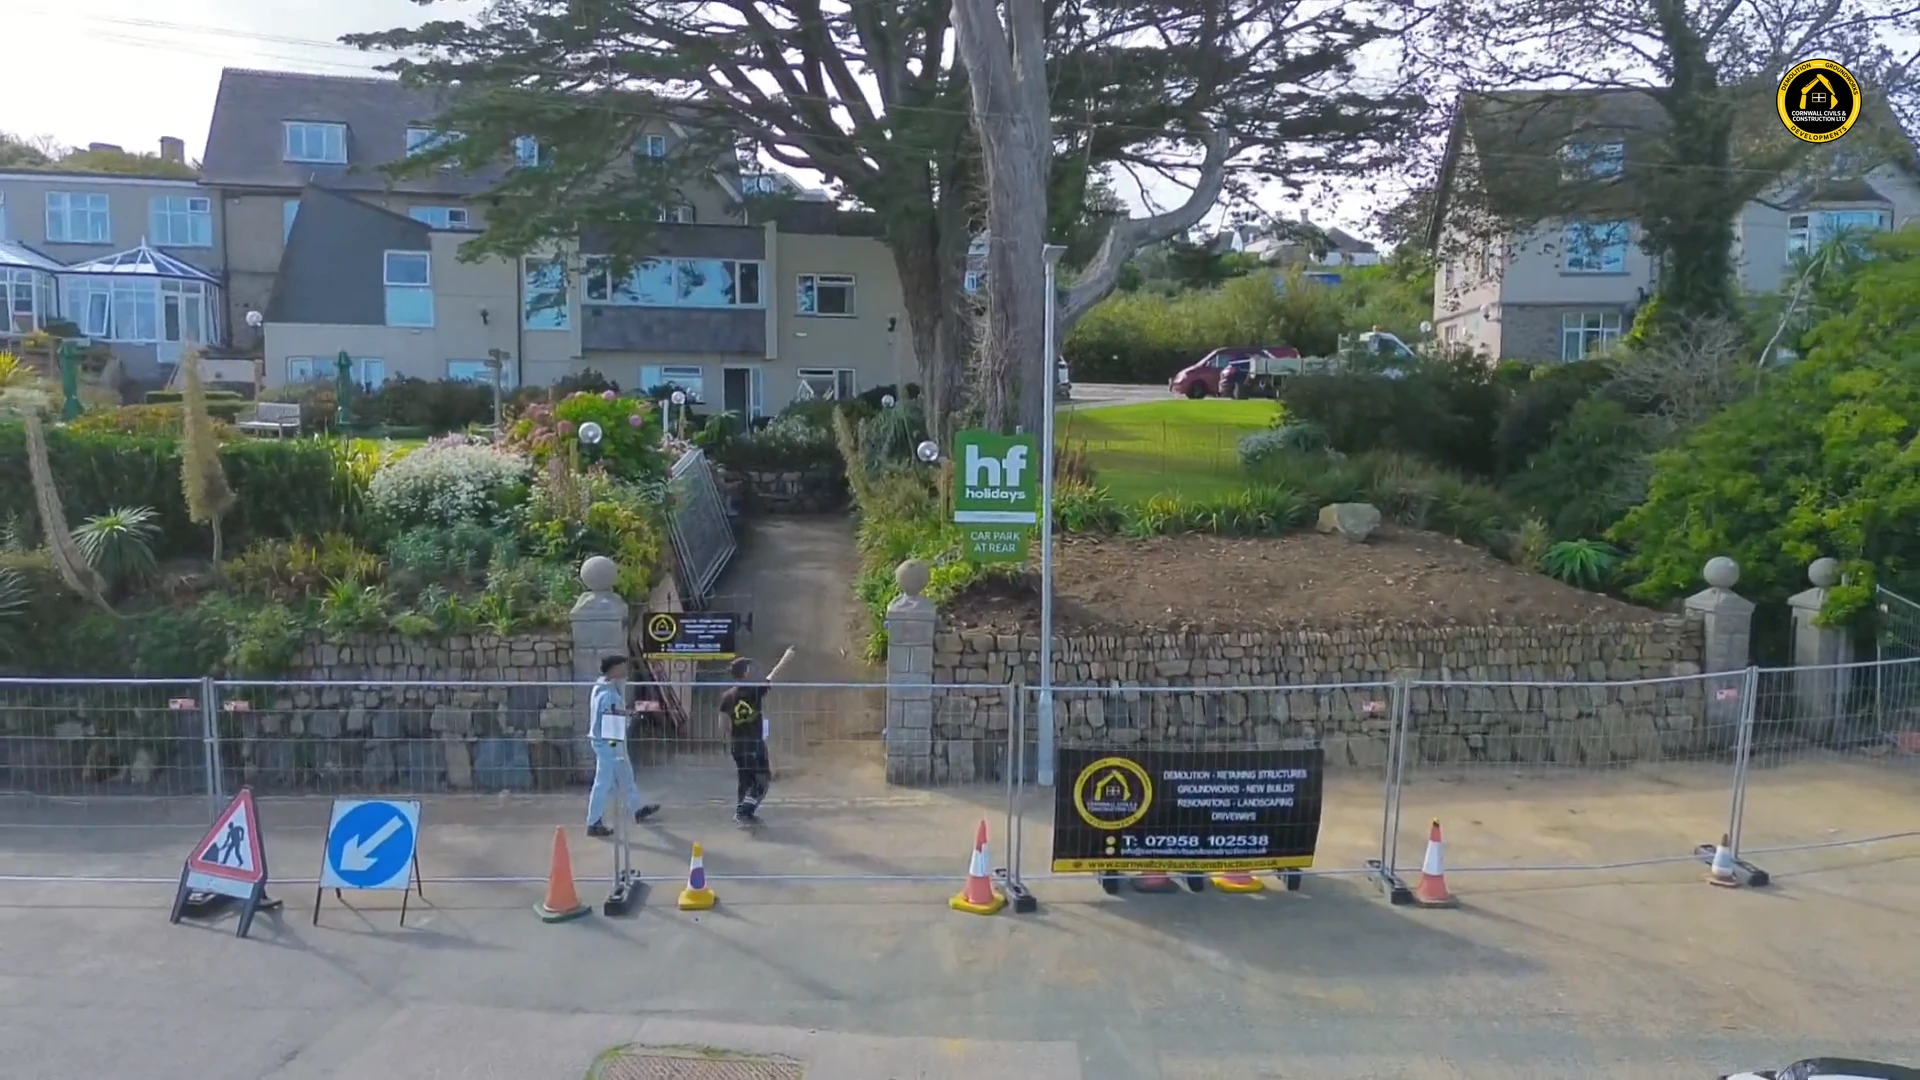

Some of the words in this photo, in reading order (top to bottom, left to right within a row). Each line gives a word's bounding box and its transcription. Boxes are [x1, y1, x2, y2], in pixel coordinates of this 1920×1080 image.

[965, 444, 1029, 487] hf
[965, 487, 1026, 503] holidays
[970, 531, 991, 541] CAR
[993, 531, 1020, 541] PARK
[973, 543, 987, 552] AT
[988, 543, 1016, 553] REAR
[1163, 770, 1211, 780] DEMOLITION
[1216, 770, 1256, 780] RETAINING
[1257, 769, 1307, 780] STRUCTURES
[1177, 784, 1240, 794] GROUNDWORKS
[1246, 784, 1265, 793] NEW
[1266, 784, 1295, 793] BUILDS
[1177, 798, 1230, 808] RENOVATIONS
[1237, 797, 1294, 807] LANDSCAPING
[1211, 812, 1256, 821] DRIVEWAYS
[1122, 835, 1138, 847] T:
[1145, 834, 1200, 847] 07958
[1206, 834, 1269, 847] 102538
